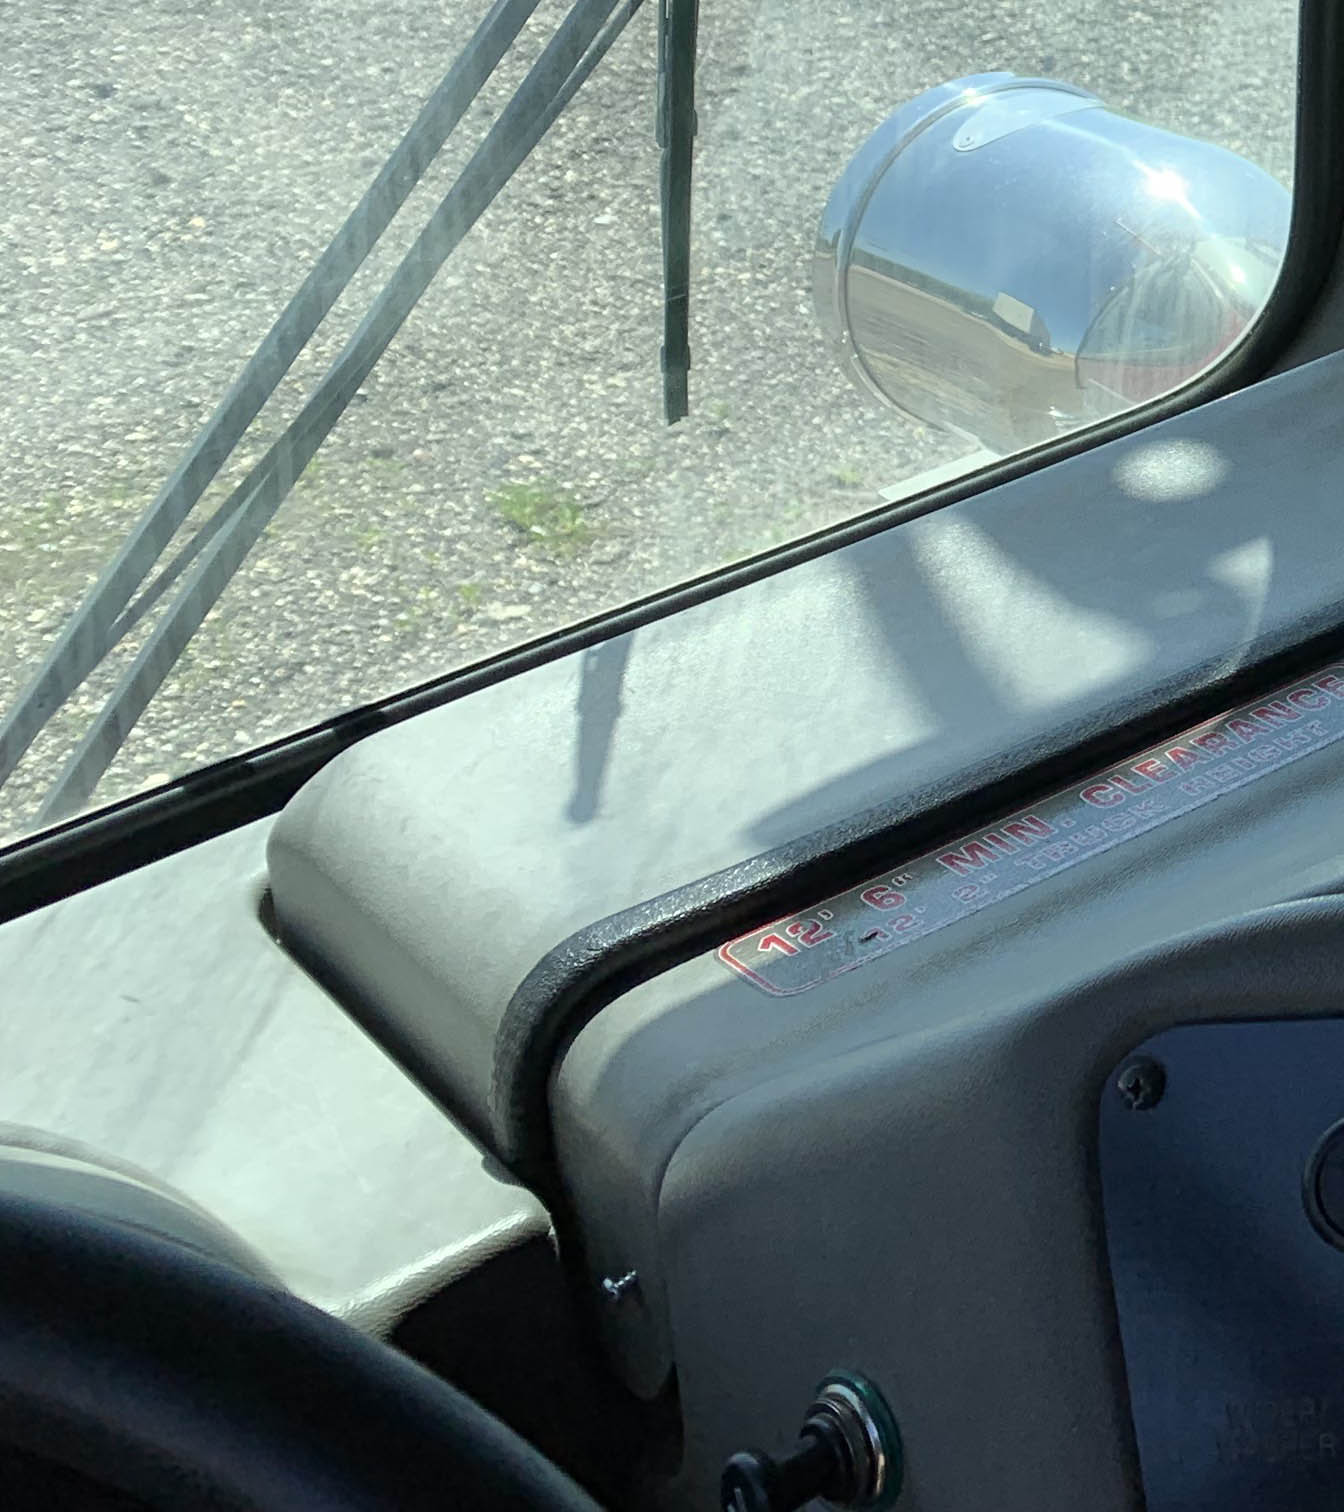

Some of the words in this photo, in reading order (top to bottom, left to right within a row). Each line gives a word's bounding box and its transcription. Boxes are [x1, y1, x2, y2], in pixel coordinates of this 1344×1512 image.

[1014, 797, 1166, 871] TRUCK
[1177, 719, 1330, 797] HEIGHT
[757, 909, 834, 957] 12'
[935, 814, 1077, 878] MIN.
